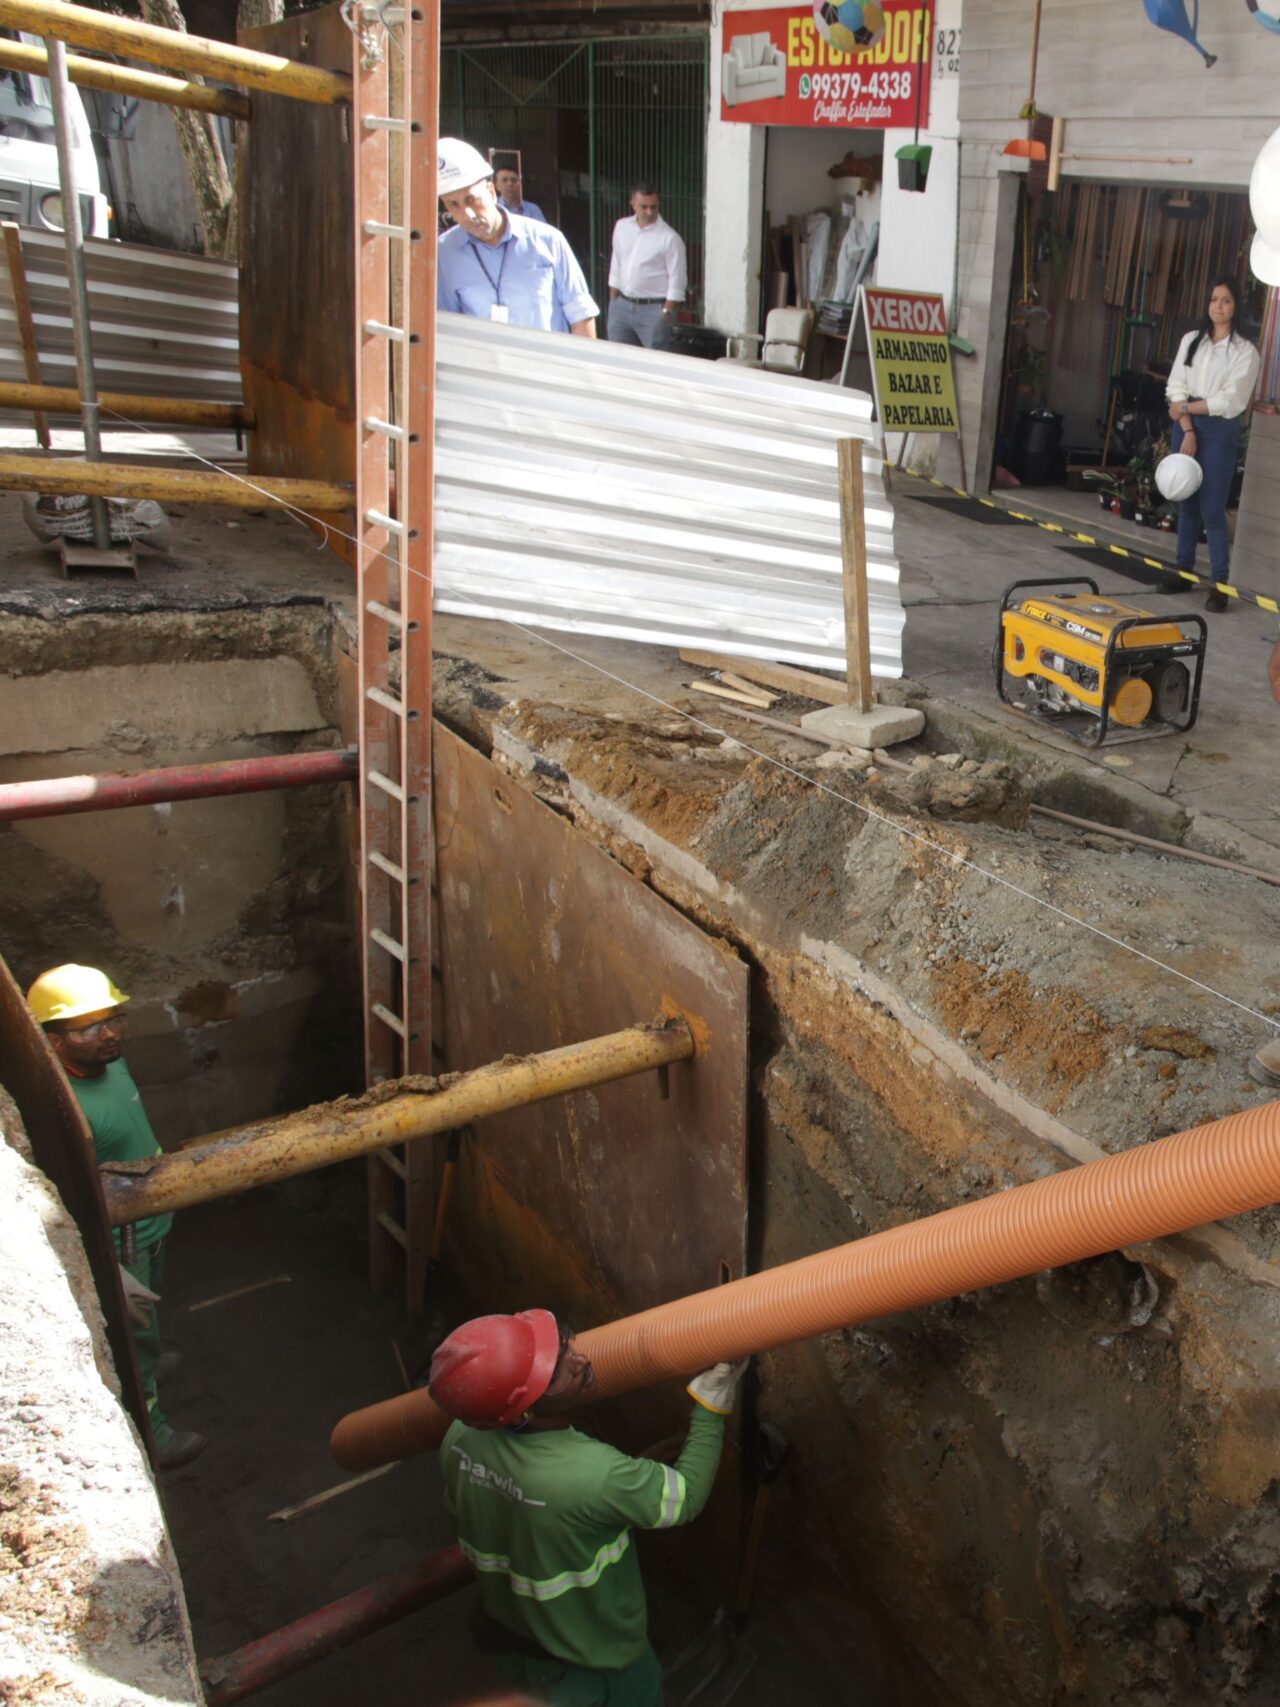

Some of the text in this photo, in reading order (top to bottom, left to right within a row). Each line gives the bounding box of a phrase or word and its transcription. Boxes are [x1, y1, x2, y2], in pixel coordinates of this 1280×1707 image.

[937, 30, 961, 55] 82
[812, 71, 911, 99] 99379-4338
[870, 296, 944, 332] XEROX
[876, 338, 947, 363] ARMARINHO
[889, 373, 942, 394] BAZAR E
[884, 405, 954, 426] PAPELARIA
[1066, 621, 1086, 636] CSM
[456, 1448, 523, 1500] Darwin
